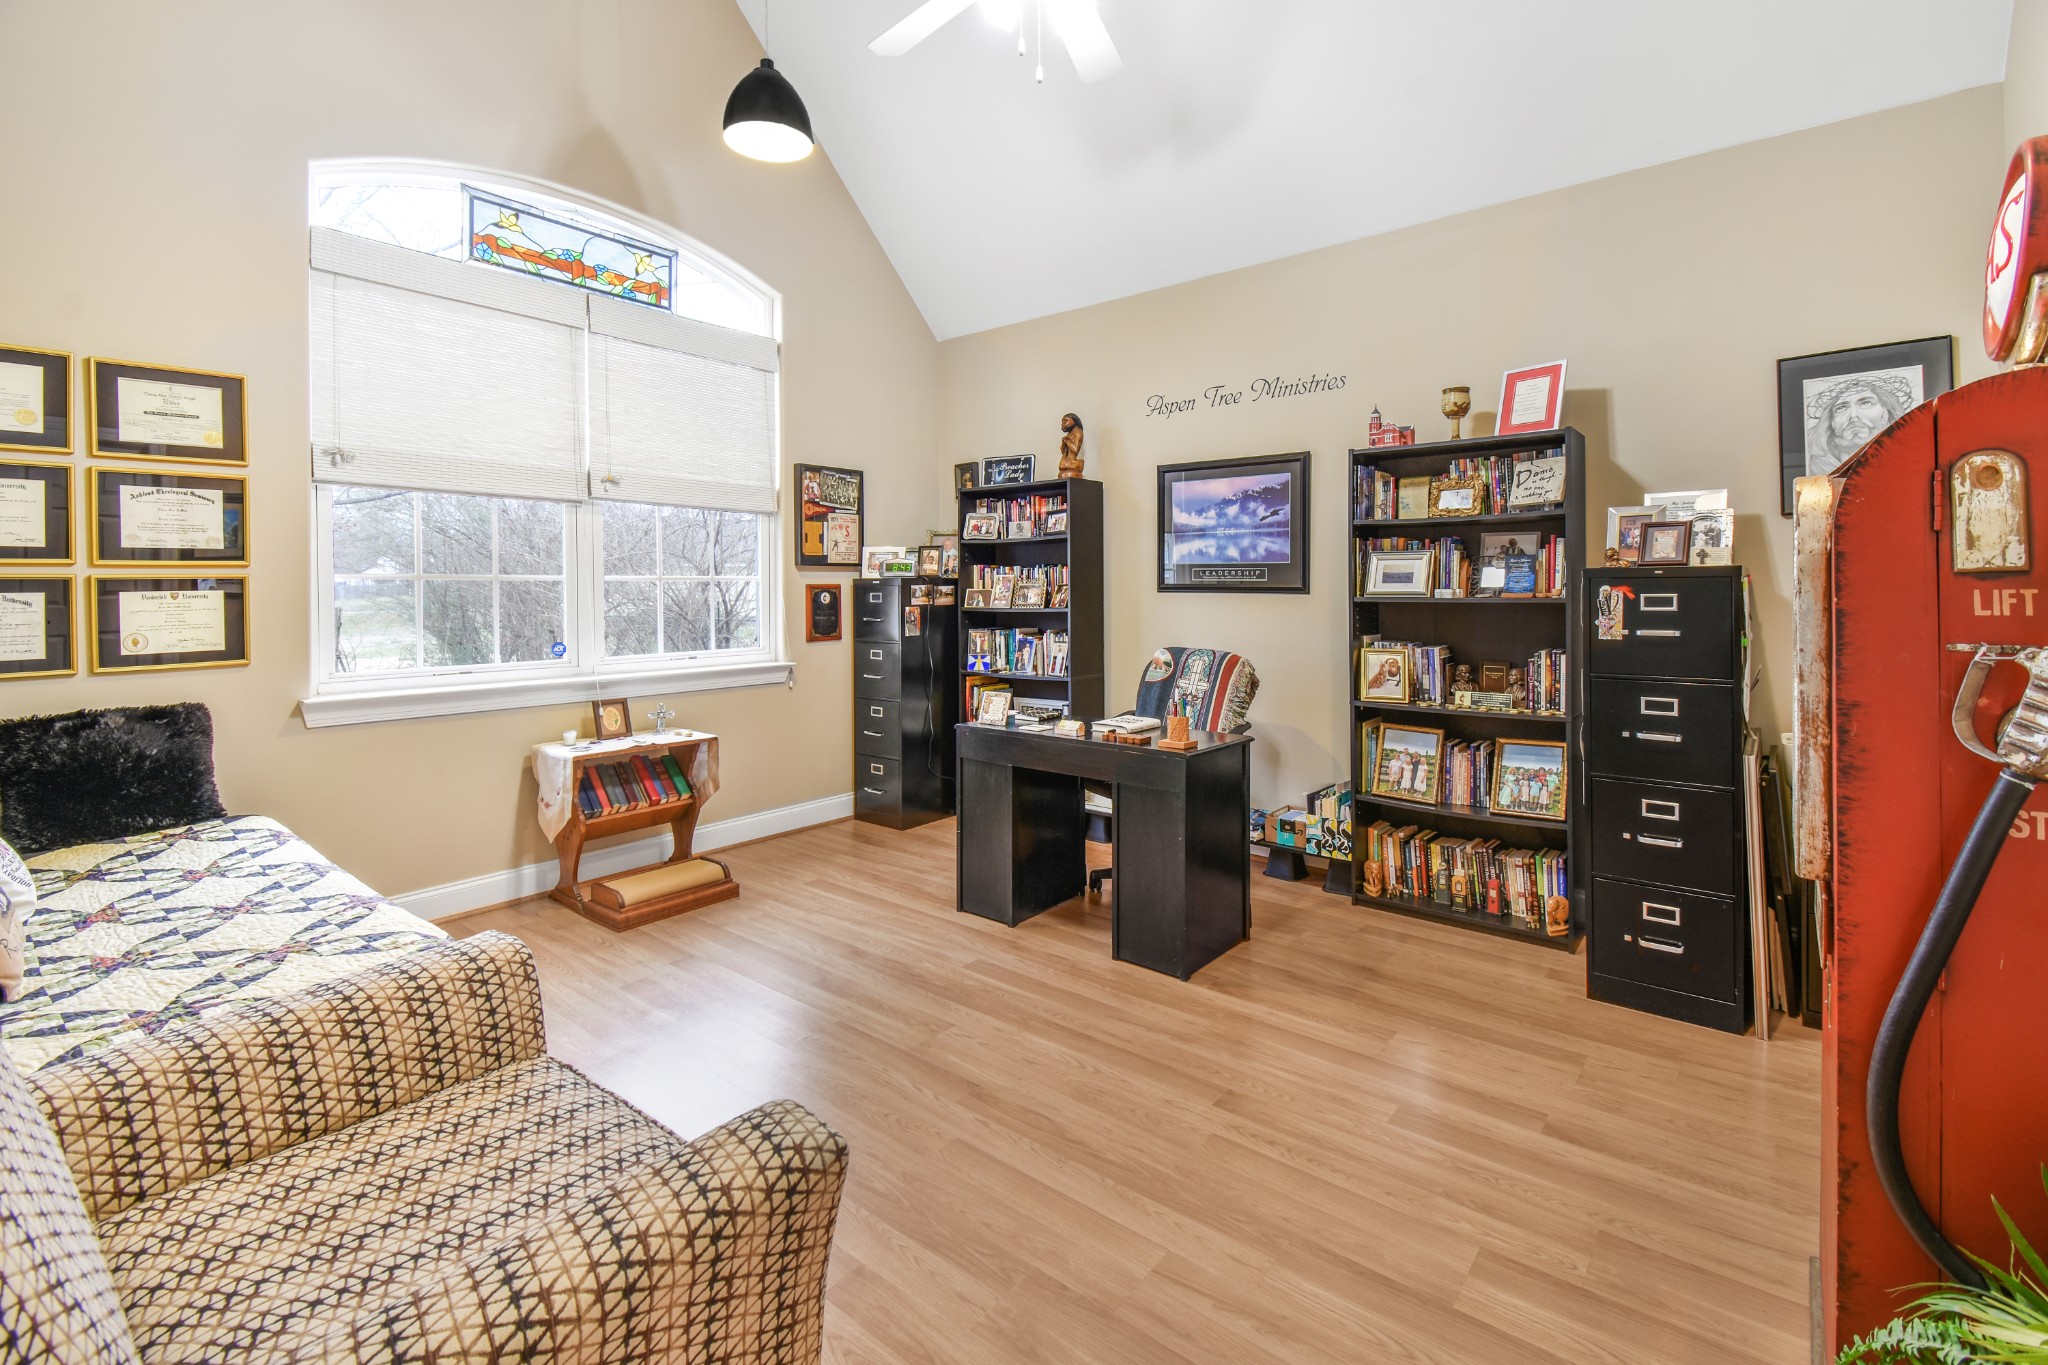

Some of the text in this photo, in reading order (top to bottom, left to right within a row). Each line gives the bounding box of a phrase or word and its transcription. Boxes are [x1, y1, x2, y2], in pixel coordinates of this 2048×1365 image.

[1146, 373, 1347, 419] Aspen Tree Ministries
[999, 461, 1029, 471] Preacher
[1004, 469, 1024, 480] Lady
[1516, 467, 1554, 489] Dance
[129, 490, 155, 500] Ashland
[155, 488, 189, 496] Theological
[892, 563, 912, 572] 8:43
[1974, 589, 2039, 616] LIFT
[3, 871, 33, 888] HOLIDAY
